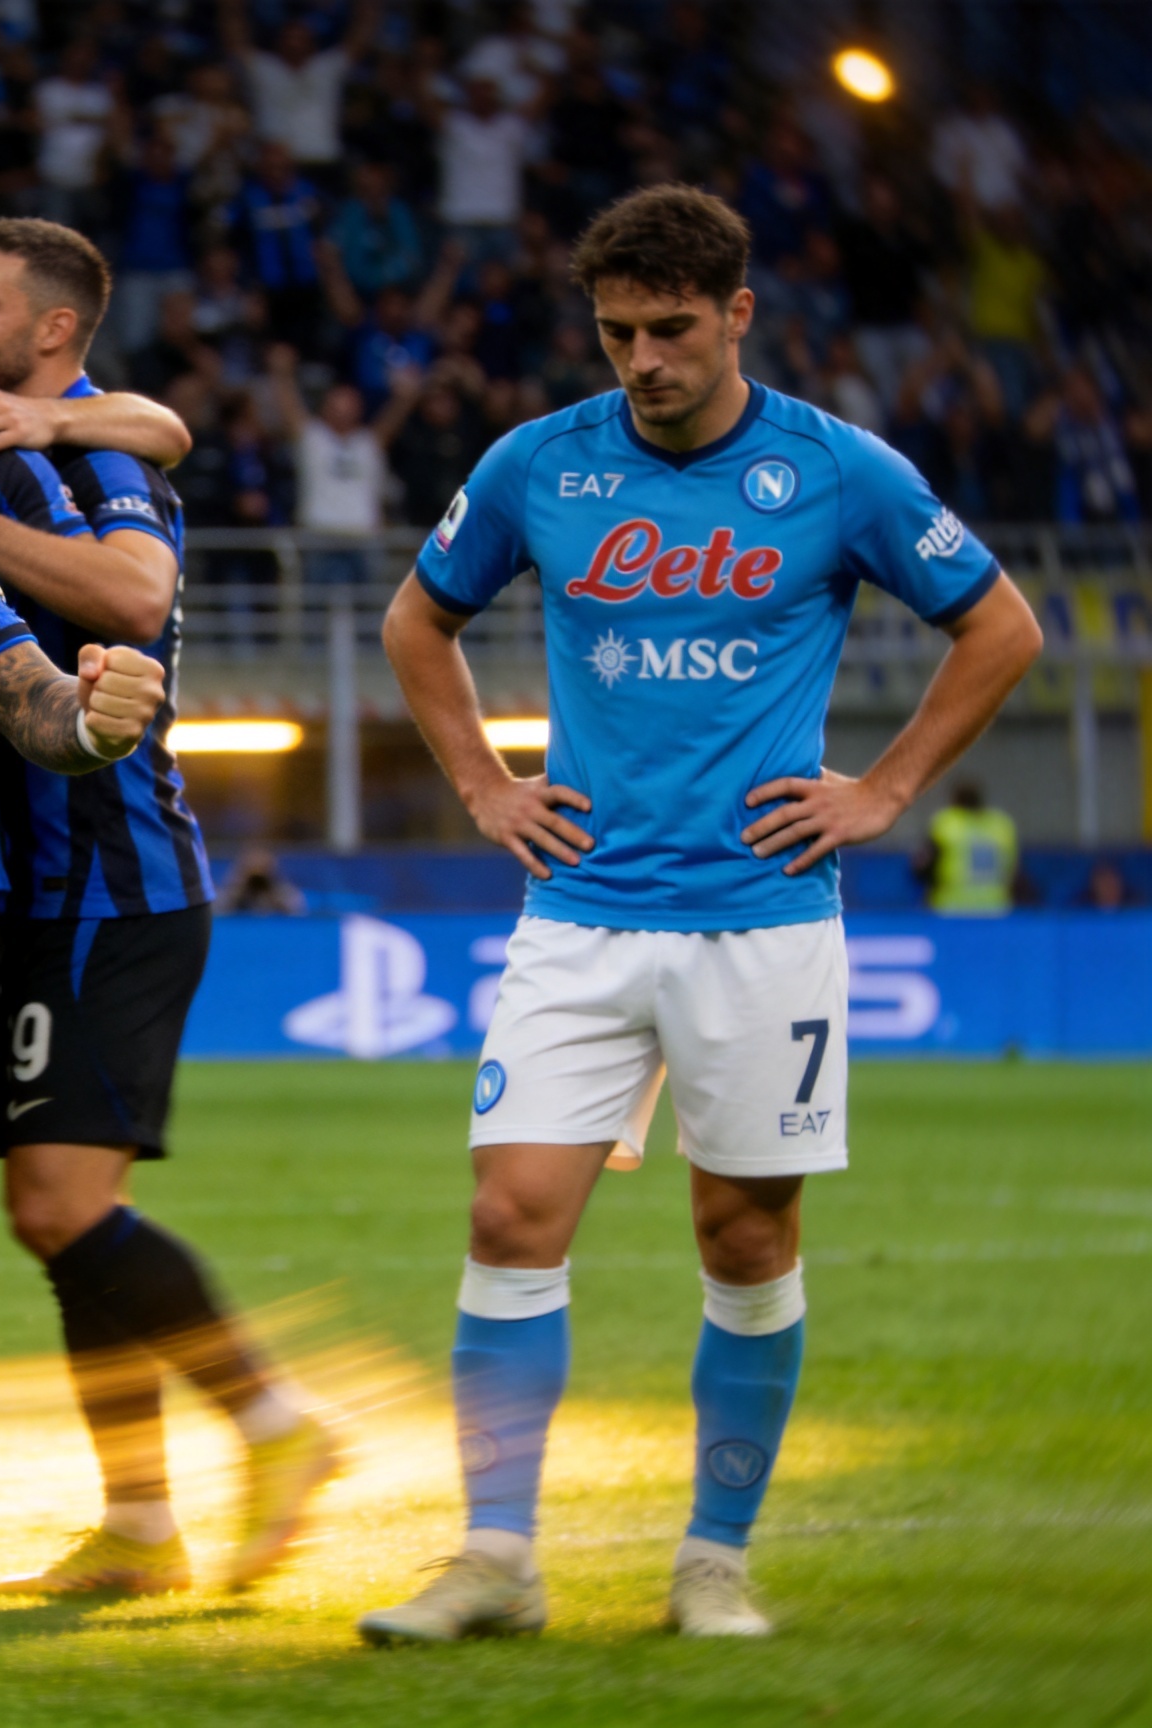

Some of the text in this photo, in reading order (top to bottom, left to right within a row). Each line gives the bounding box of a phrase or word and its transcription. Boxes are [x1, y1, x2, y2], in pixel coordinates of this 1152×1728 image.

[559, 472, 625, 498] EA7
[755, 469, 785, 500] N
[565, 517, 783, 604] Lete
[637, 638, 758, 681] MSC
[12, 1001, 53, 1082] 9
[791, 1018, 829, 1104] 7
[779, 1110, 831, 1137] EA7
